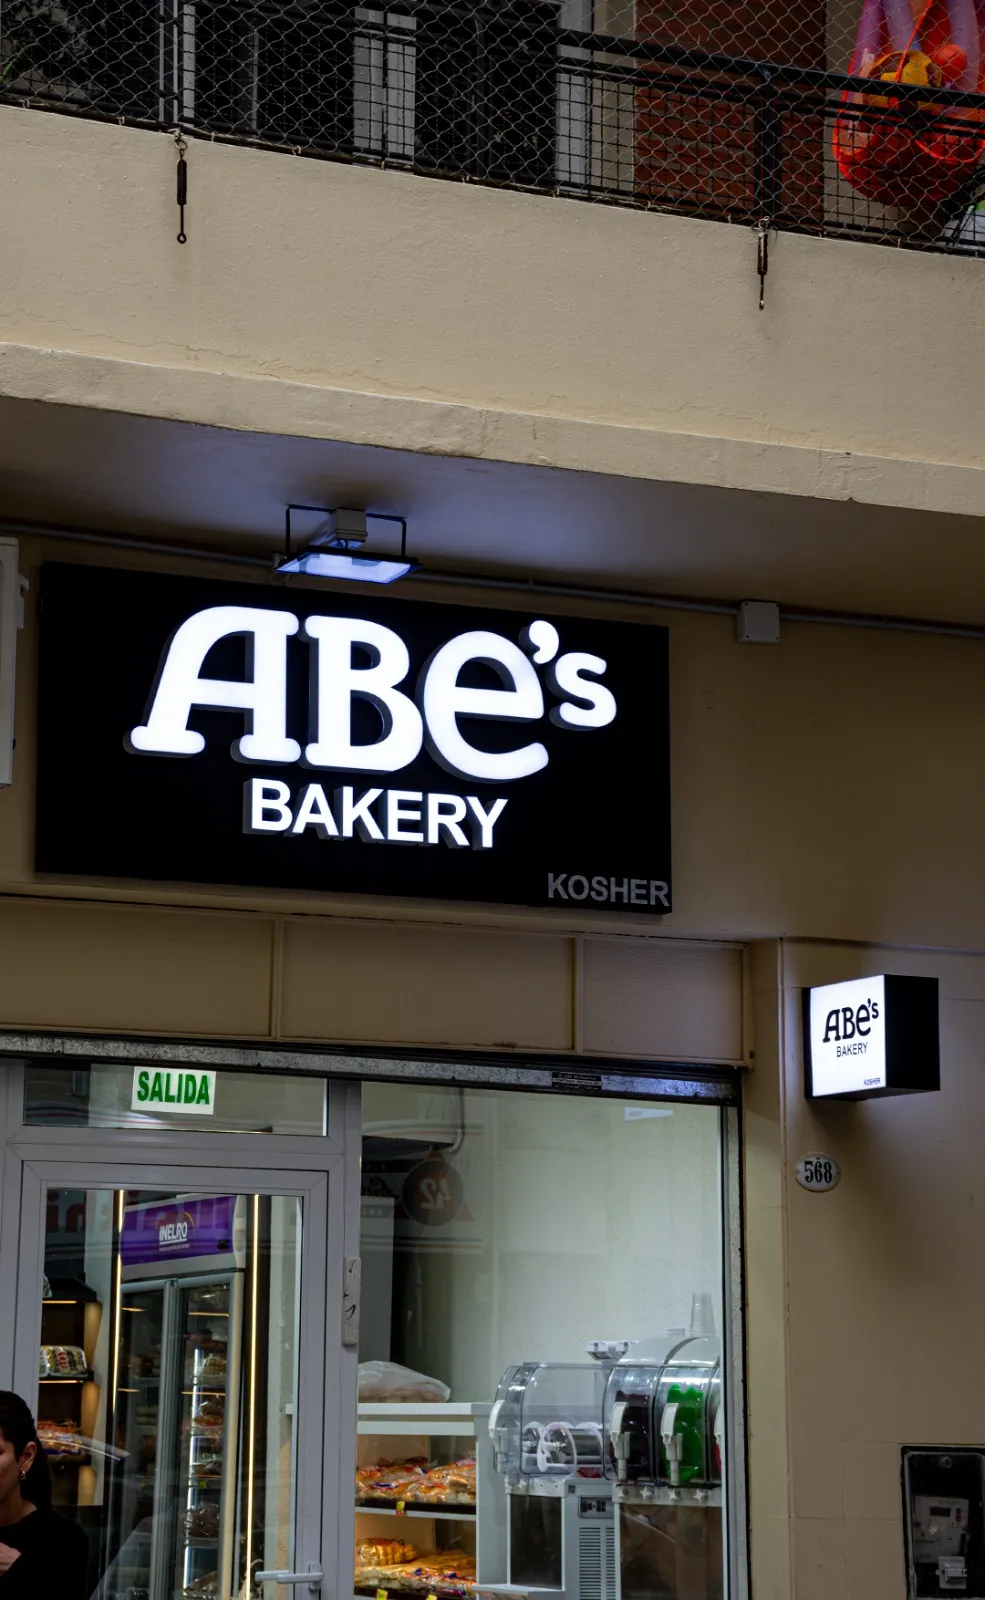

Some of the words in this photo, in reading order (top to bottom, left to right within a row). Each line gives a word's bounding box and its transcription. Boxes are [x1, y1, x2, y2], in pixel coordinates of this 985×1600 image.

[129, 606, 617, 780] ABe's
[250, 777, 508, 850] BAKERY
[547, 873, 670, 908] KOSHER
[836, 1042, 868, 1057] BAKERY
[136, 1071, 210, 1105] SALIDA
[804, 1161, 833, 1184] 568
[159, 1221, 188, 1242] INELRO
